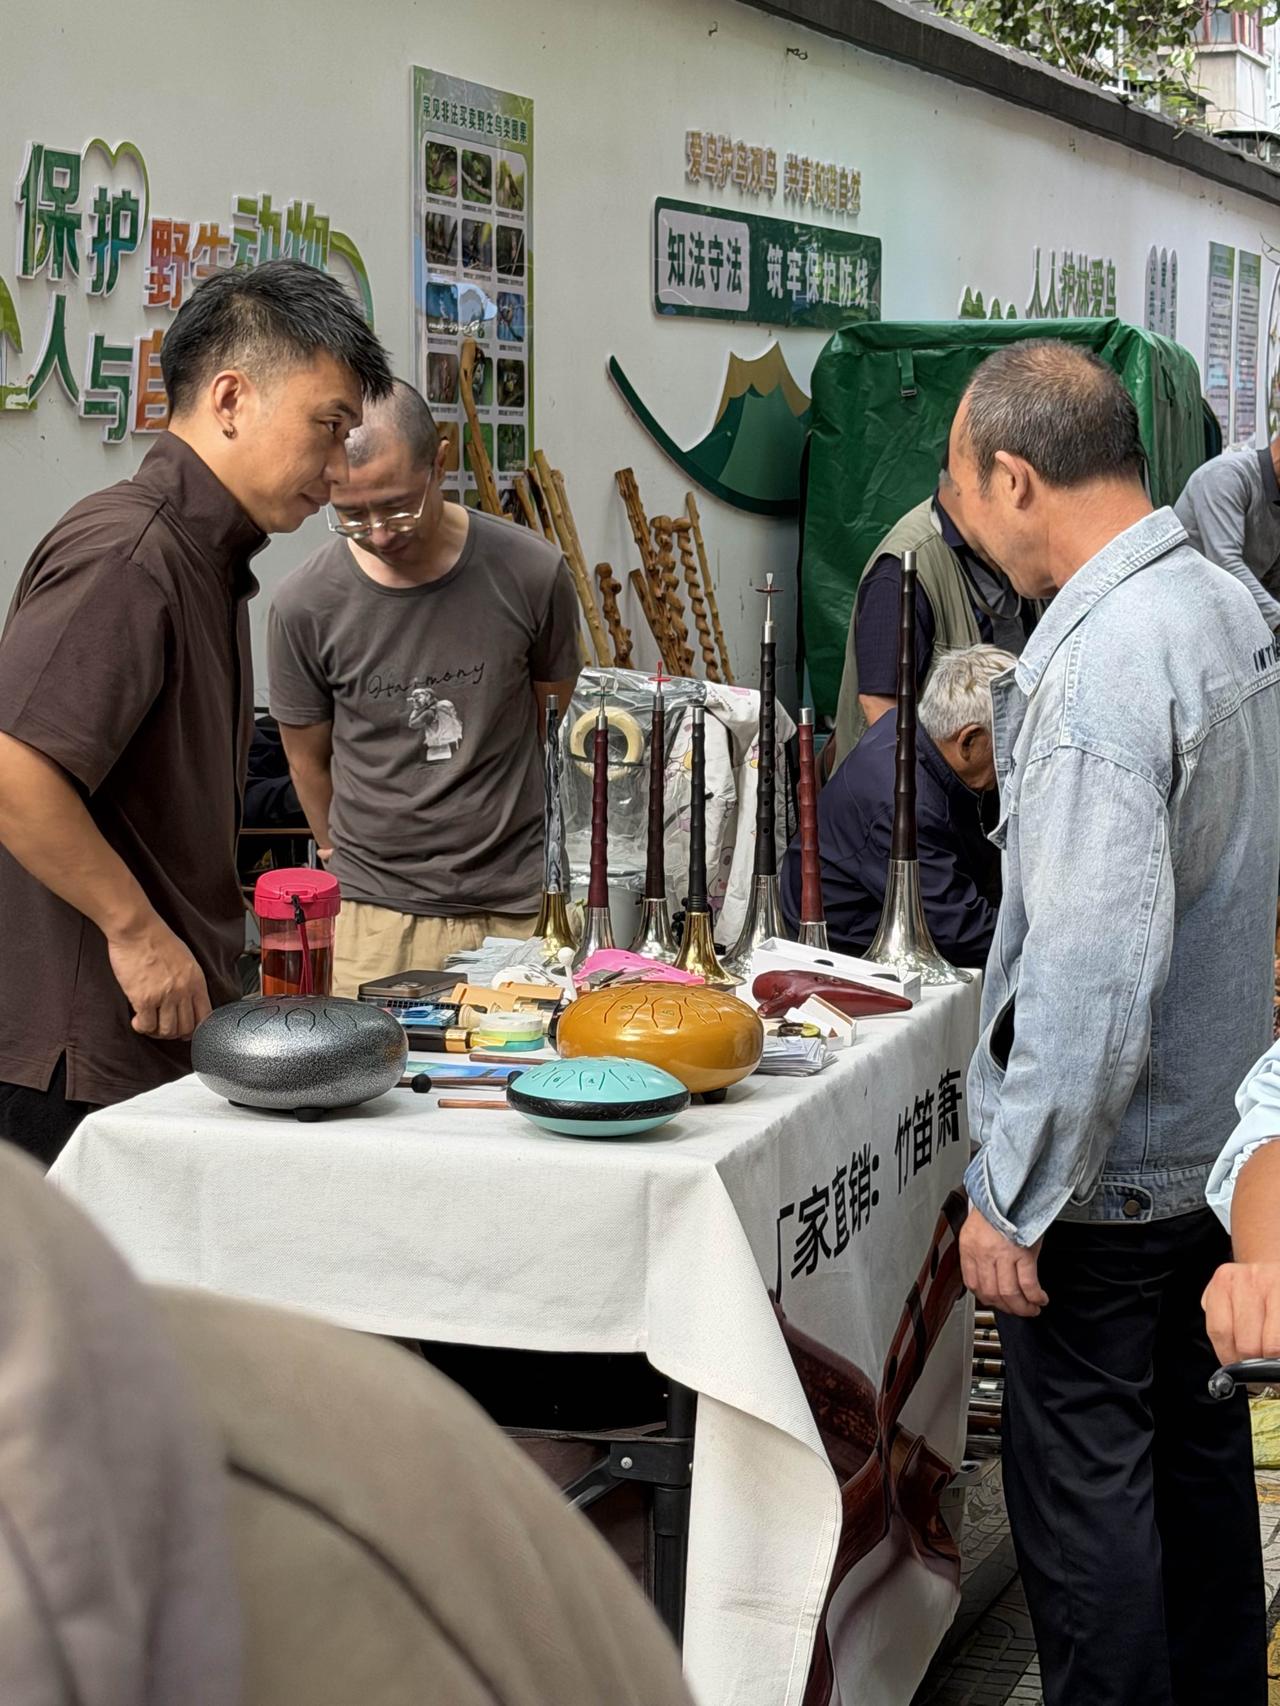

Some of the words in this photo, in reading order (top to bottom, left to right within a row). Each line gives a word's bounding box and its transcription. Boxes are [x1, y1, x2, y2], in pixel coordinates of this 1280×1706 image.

[423, 94, 527, 143] 常见非法买卖野生鸟类图集
[686, 131, 777, 199] 爱鸟护鸟观鸟
[15, 140, 331, 310] 保护野生动物
[667, 228, 743, 293] 知法守法
[767, 242, 868, 308] 筑牢保护防线
[1253, 643, 1278, 673] INT
